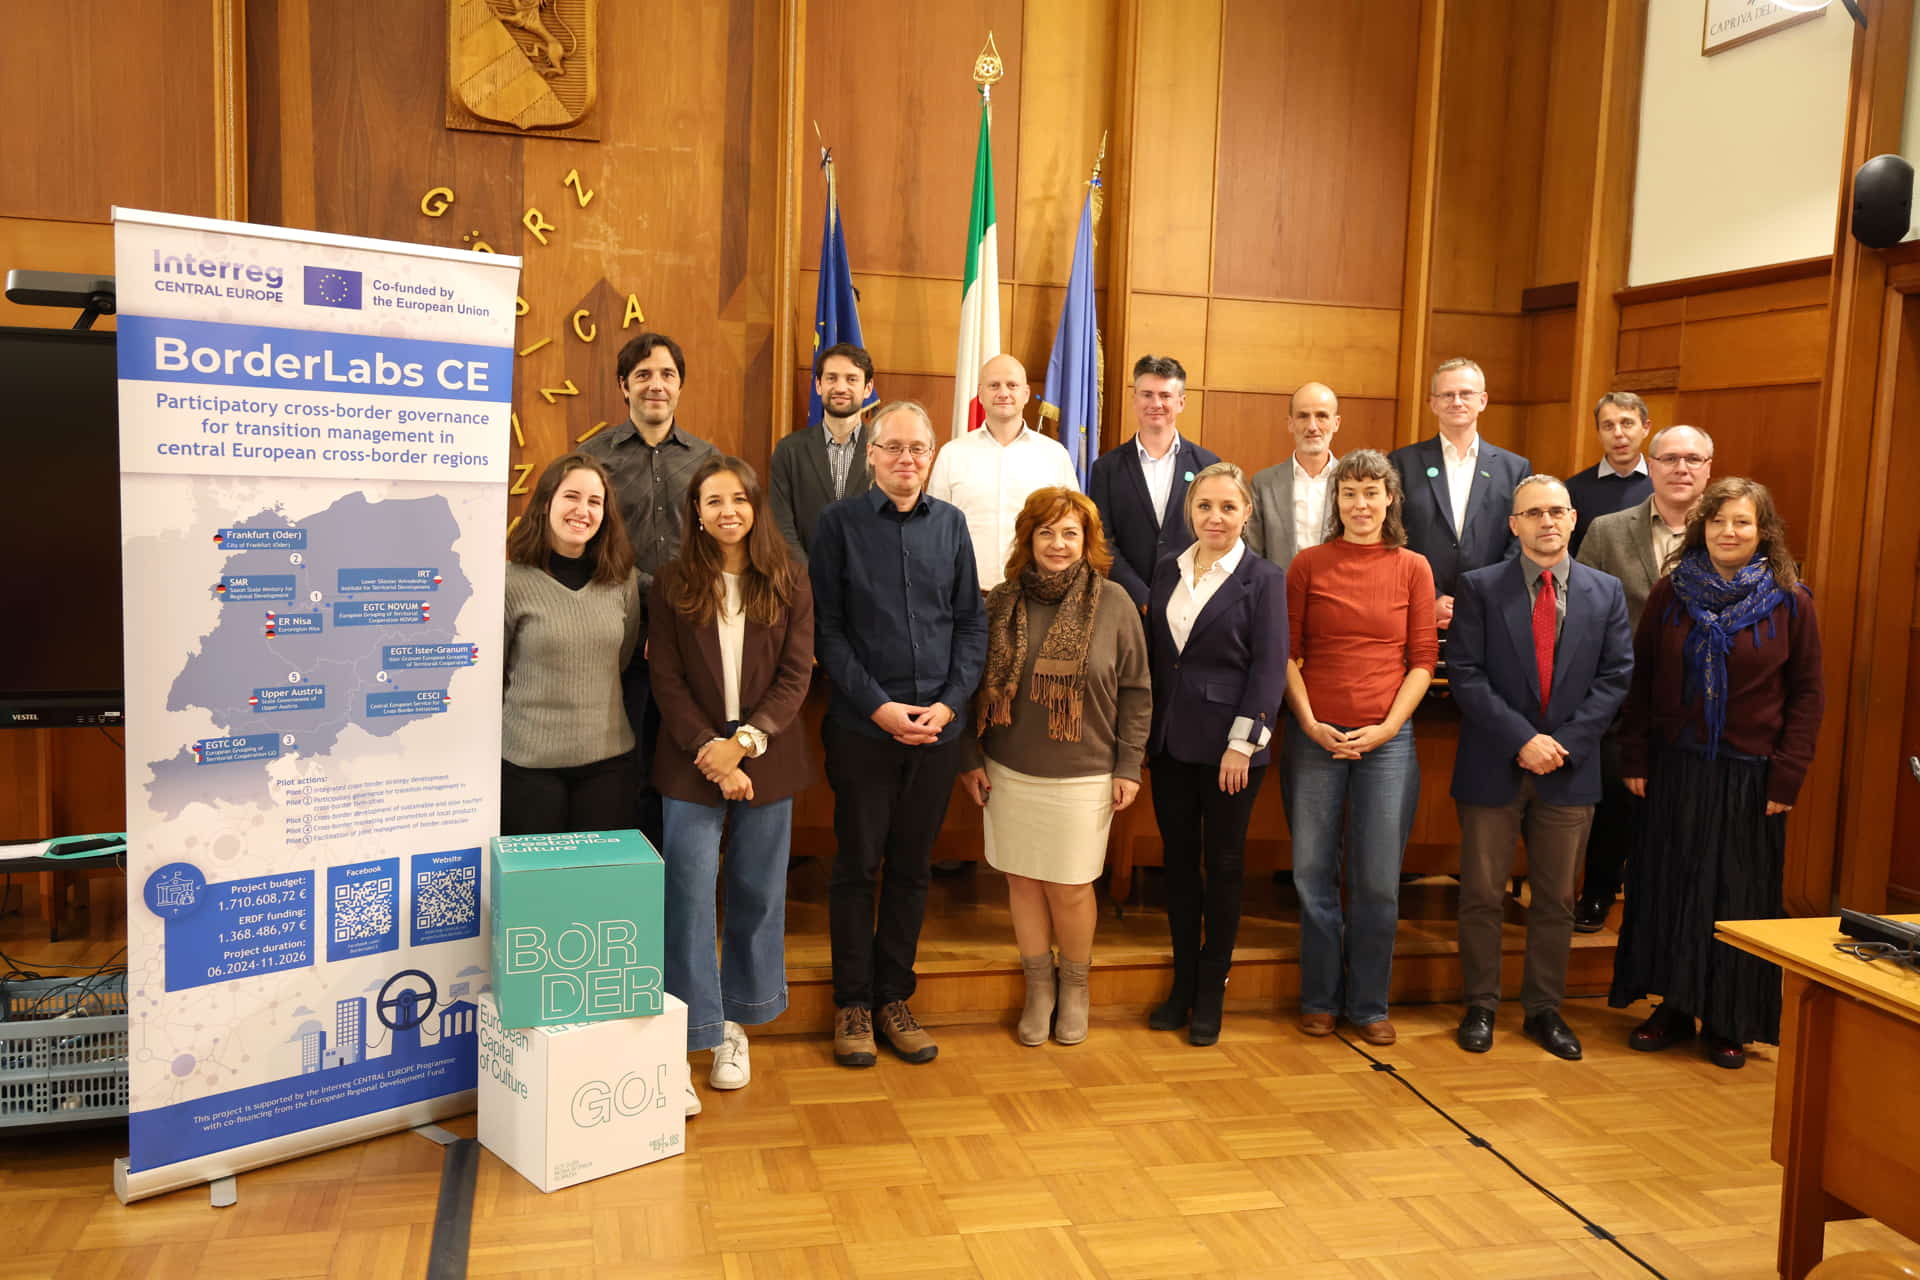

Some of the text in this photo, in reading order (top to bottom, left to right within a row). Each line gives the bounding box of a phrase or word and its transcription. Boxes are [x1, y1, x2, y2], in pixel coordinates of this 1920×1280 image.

[154, 249, 283, 288] Interreg
[154, 280, 284, 303] CENTRAL EUROPE
[373, 279, 454, 300] Co-funded by
[373, 294, 490, 317] the European Union
[155, 336, 490, 392] BorderLabs CE
[157, 393, 490, 427] Participatory cross-border governance
[201, 418, 455, 448] for transition management in
[157, 441, 489, 469] central European cross-border regions
[226, 530, 302, 541] Frankfurt (Oder)
[229, 578, 249, 587] SMR
[416, 569, 431, 578] IRT
[363, 602, 418, 612] EGTC NOVUM
[278, 616, 312, 626] ER Nisa
[390, 647, 414, 656] EGTC
[261, 687, 323, 700] Upper Austria
[11, 713, 40, 721] VESTEL
[205, 738, 247, 750] EGTC GO
[276, 776, 329, 787] Pilot actions:
[346, 865, 382, 877] Facebook
[432, 855, 462, 865] Website
[231, 876, 306, 894] Project budget:
[218, 888, 307, 912] 1.710.608,72 €
[239, 908, 306, 926] ERDF funding:
[218, 920, 307, 944] 1.368.486,97 €
[223, 940, 306, 960] Project duration:
[505, 919, 638, 975] BOR
[207, 951, 306, 978] 06.2024-11.2026
[541, 965, 663, 1021] DER
[480, 1026, 514, 1066] Capital
[479, 1053, 528, 1100] of Culture
[193, 1115, 211, 1124] This
[212, 1106, 243, 1121] project
[253, 1094, 294, 1111] supported
[294, 1092, 305, 1101] by
[306, 1088, 319, 1097] the
[321, 1080, 352, 1094] Interreg
[352, 1073, 386, 1087] CENTRAL
[387, 1065, 416, 1079] EUROPE
[203, 1120, 223, 1132] with
[223, 1109, 273, 1128] co-financing
[274, 1104, 294, 1114] from
[295, 1100, 309, 1110] the
[310, 1091, 346, 1106] European
[379, 1072, 425, 1089] Development
[570, 1063, 668, 1129] GO!
